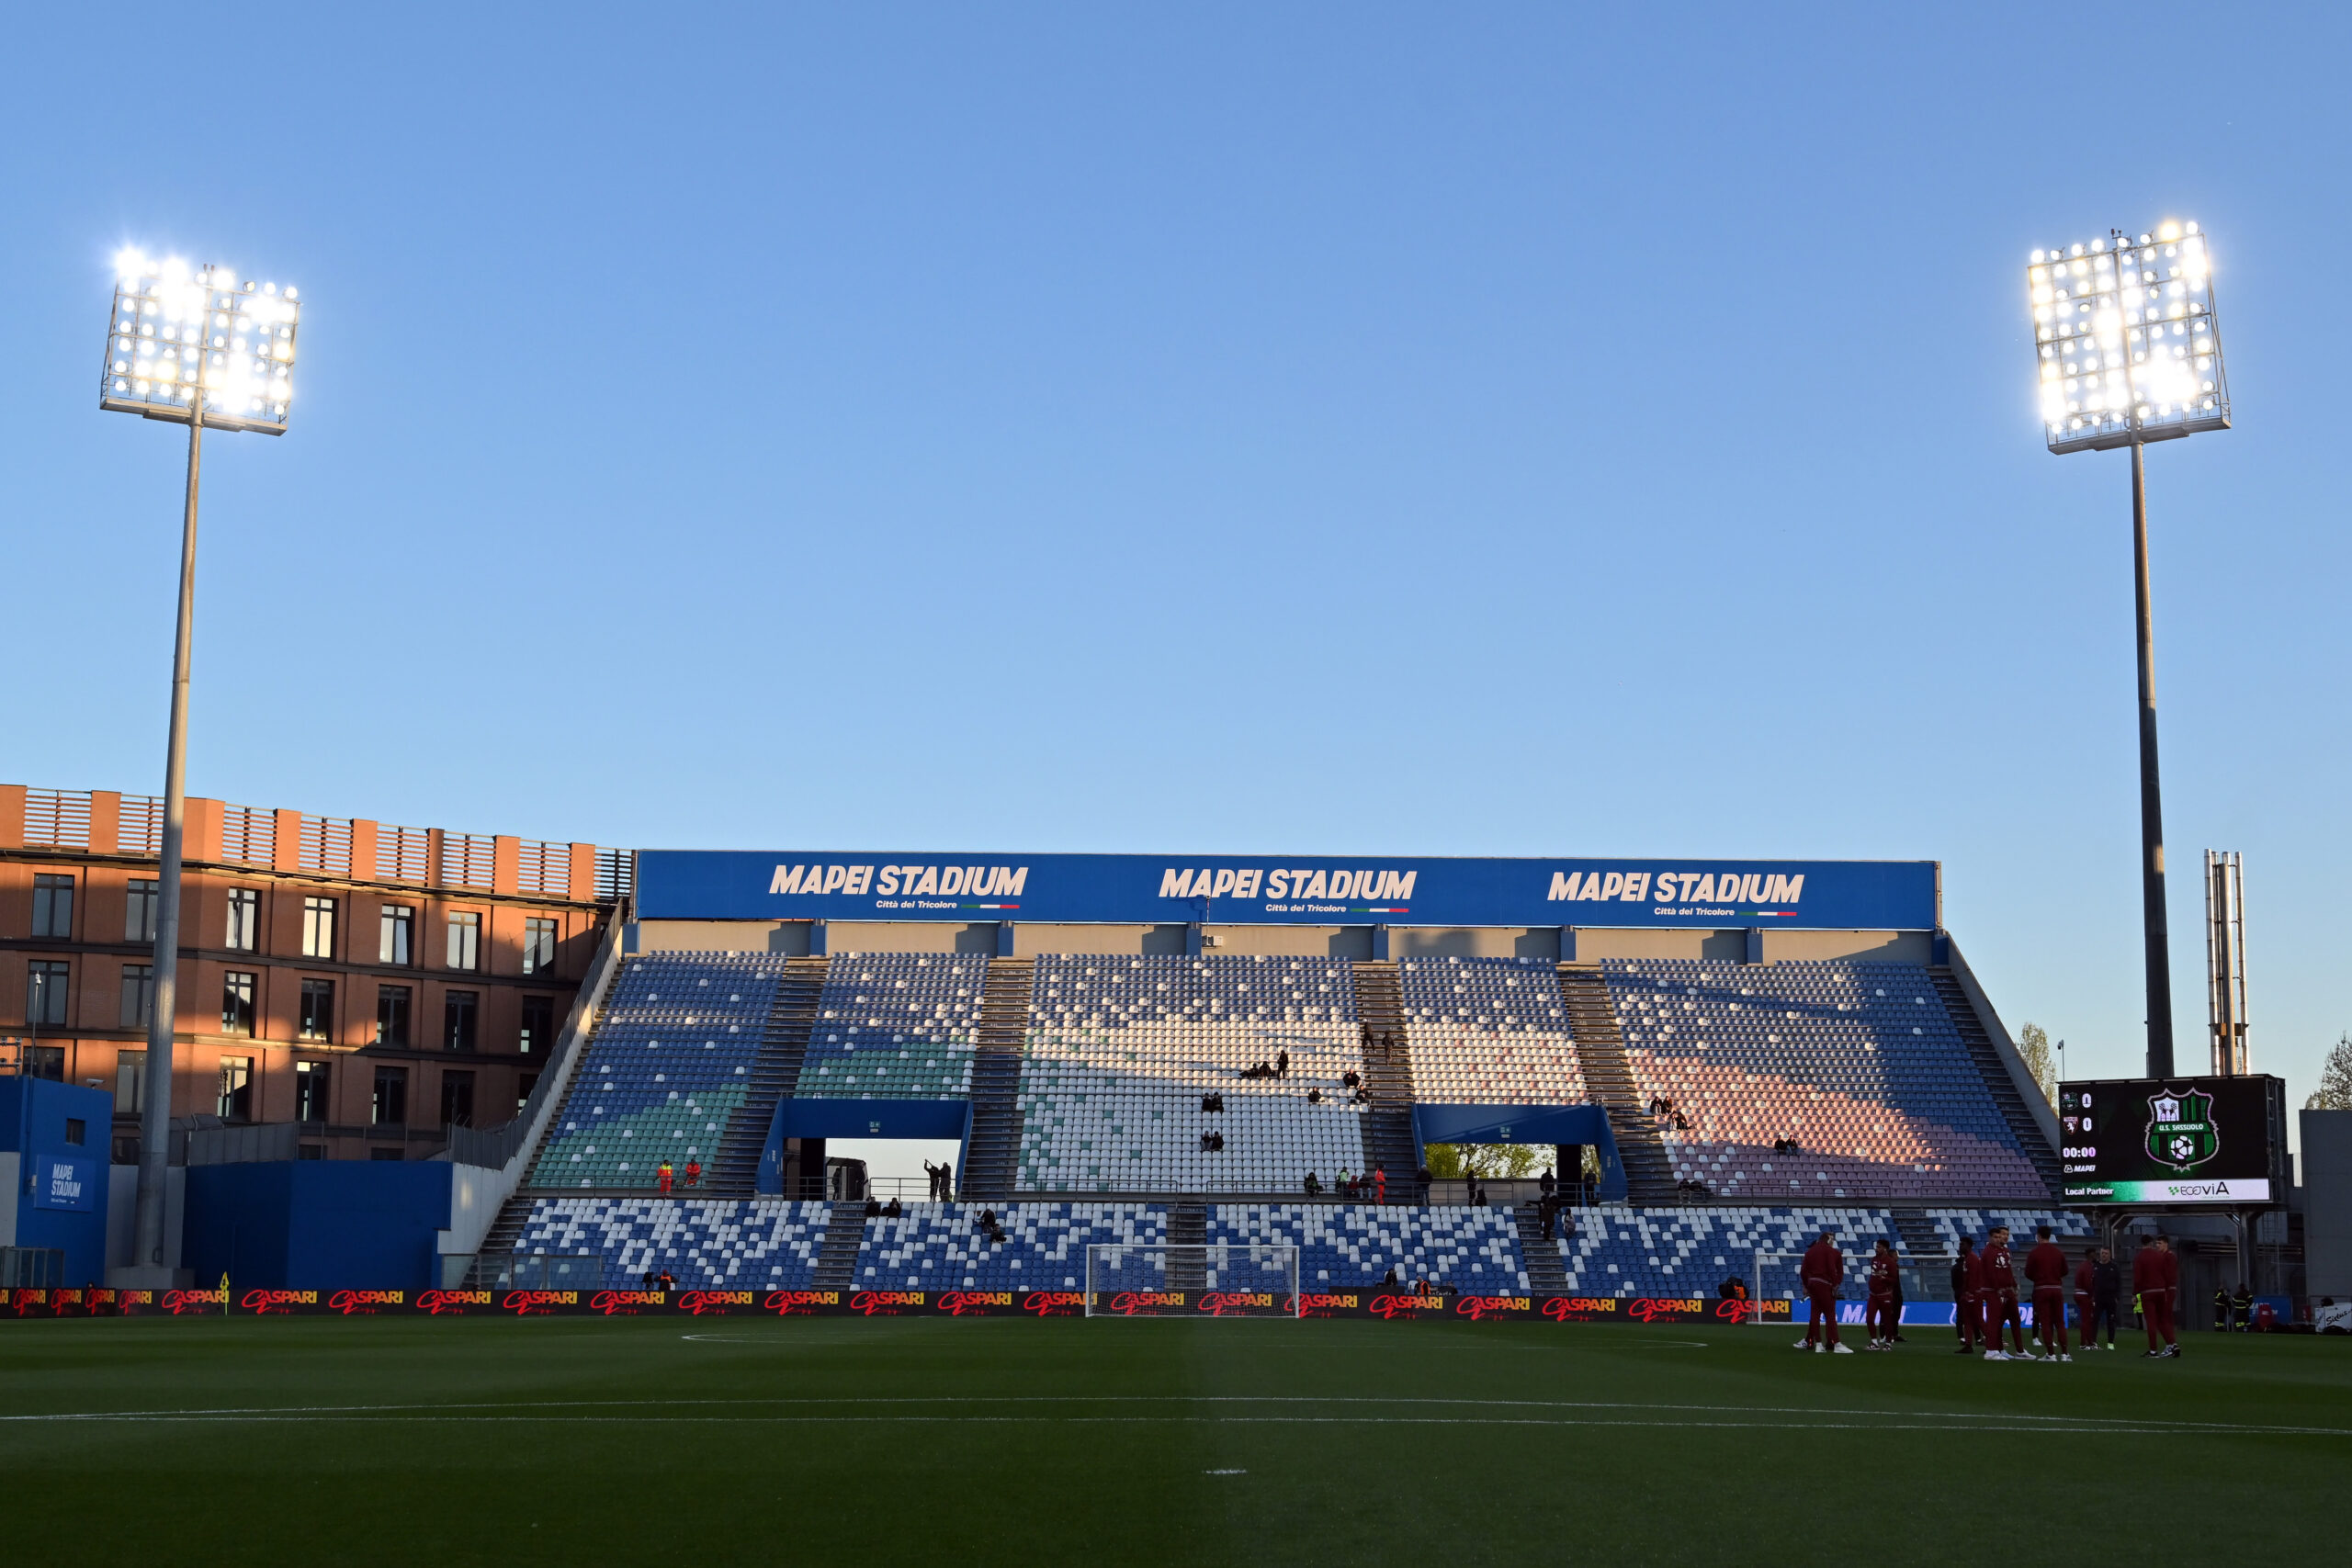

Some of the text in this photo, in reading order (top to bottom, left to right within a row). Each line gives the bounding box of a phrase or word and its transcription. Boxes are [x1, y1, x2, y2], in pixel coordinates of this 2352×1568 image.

[769, 865, 1028, 896] MAPEI STADIUM
[1159, 869, 1418, 899] MAPEI STADIUM
[1547, 872, 1804, 903] MAPEI STADIUM
[876, 900, 899, 908] Città
[1265, 904, 1287, 912] Città
[1654, 908, 1676, 916] Città
[2082, 1093, 2092, 1109] 0
[2083, 1117, 2092, 1132] 0
[2063, 1147, 2096, 1157] 00:00
[52, 1164, 74, 1180] MAPEI
[51, 1180, 81, 1198] STADIUM
[2065, 1188, 2114, 1196] Local Partner
[162, 1290, 229, 1314] GASPARI
[242, 1290, 317, 1314] GASPARI
[329, 1291, 403, 1314] GASPARI
[416, 1290, 491, 1314] GASPARI
[503, 1291, 577, 1314] GASPARI
[591, 1291, 664, 1315] GASPARI
[679, 1291, 752, 1315] GASPARI
[764, 1291, 838, 1315] GASPARI
[851, 1292, 924, 1315] GASPARI
[938, 1292, 1012, 1315] GASPARI
[1111, 1292, 1184, 1315] GASPARI
[1198, 1292, 1272, 1315] GASPARI
[1284, 1293, 1357, 1318] GASPARI
[1369, 1295, 1442, 1319] GASPARI
[1456, 1296, 1530, 1320] GASPARI
[1543, 1297, 1615, 1322] GASPARI
[1629, 1298, 1702, 1323] GASPARI
